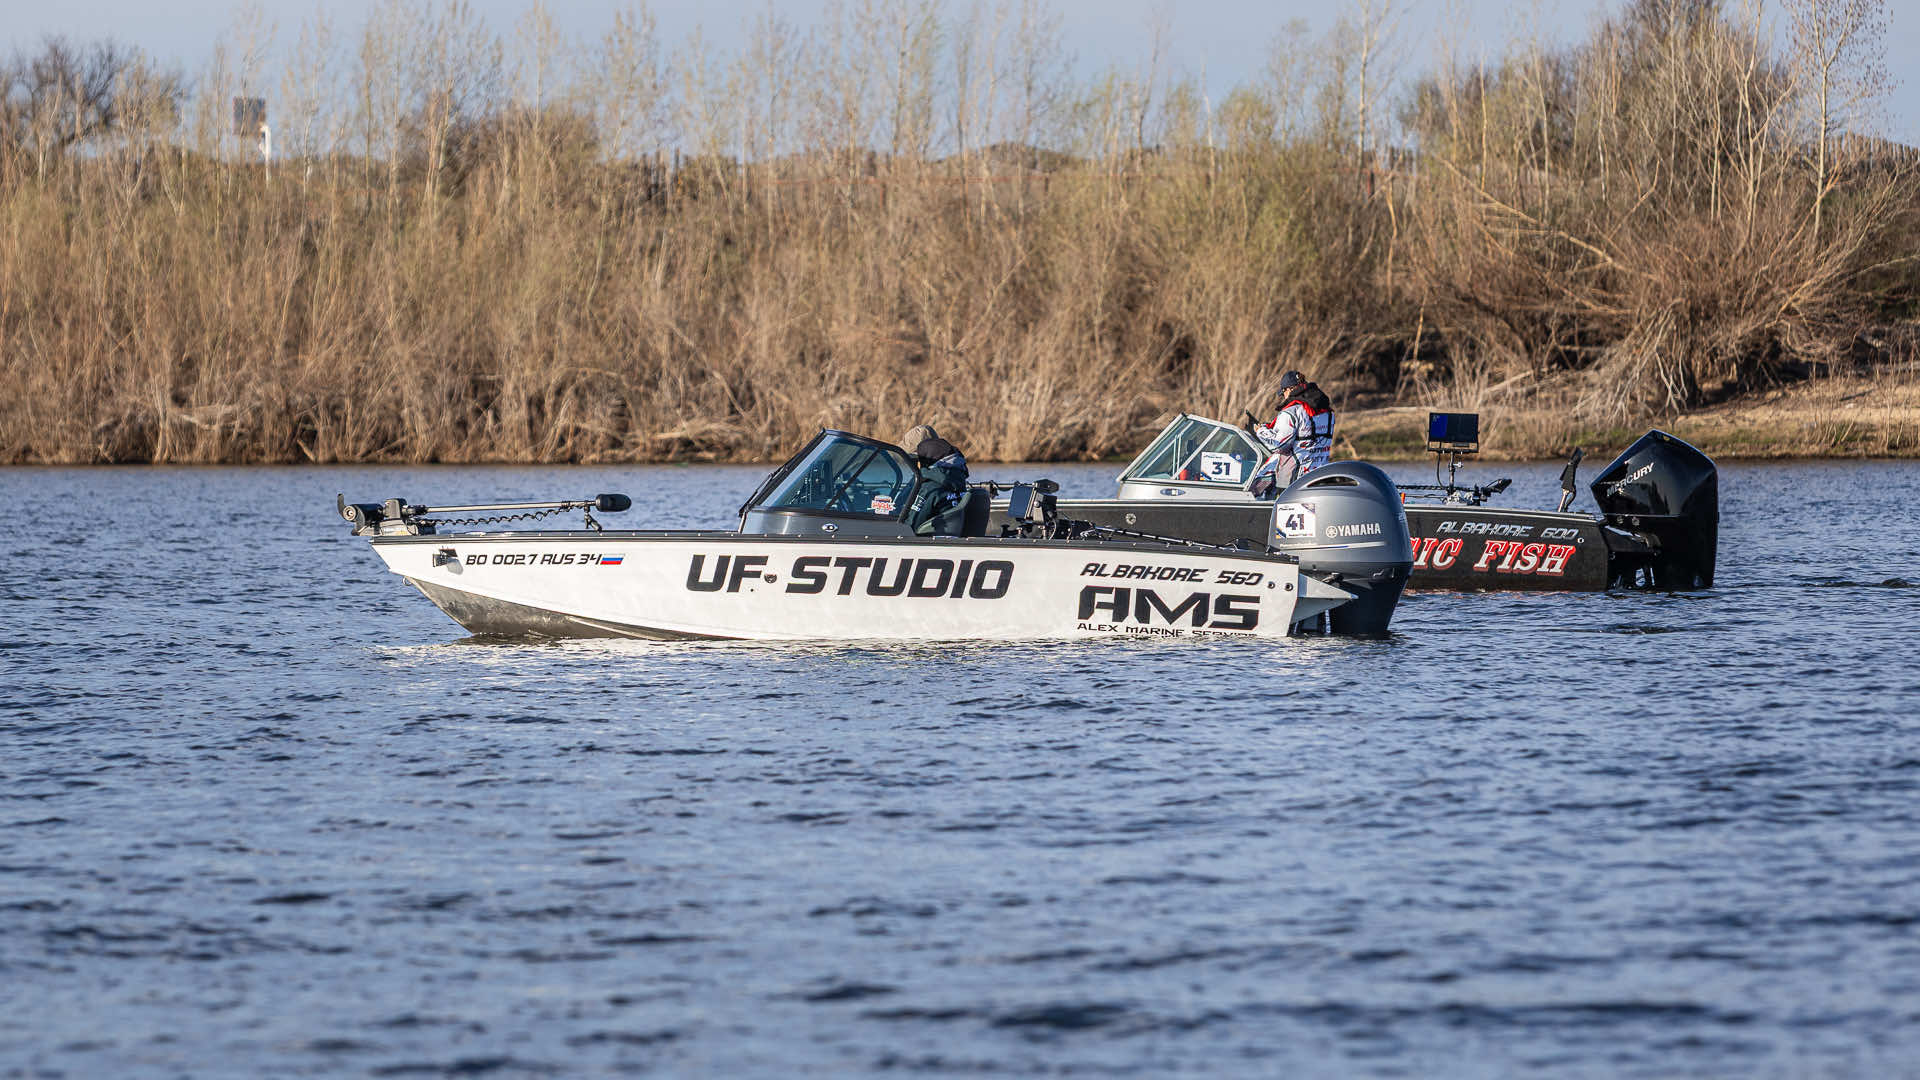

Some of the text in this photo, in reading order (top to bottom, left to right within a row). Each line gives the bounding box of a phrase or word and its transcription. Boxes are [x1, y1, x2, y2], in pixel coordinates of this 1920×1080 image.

[1212, 461, 1231, 476] 31
[1606, 462, 1655, 497] MERCURY
[1285, 513, 1305, 531] 41
[1337, 523, 1382, 537] YAMAHA
[1540, 526, 1580, 541] 600
[492, 553, 538, 566] 0027
[540, 553, 576, 565] RUS
[577, 553, 602, 566] 34
[1473, 539, 1577, 577] FISH
[785, 556, 1015, 600] STUDIO
[1079, 562, 1265, 586] ALBAKORE 560
[1077, 585, 1261, 631] AMS
[1076, 622, 1119, 633] ALEX
[1125, 625, 1185, 639] MARINE
